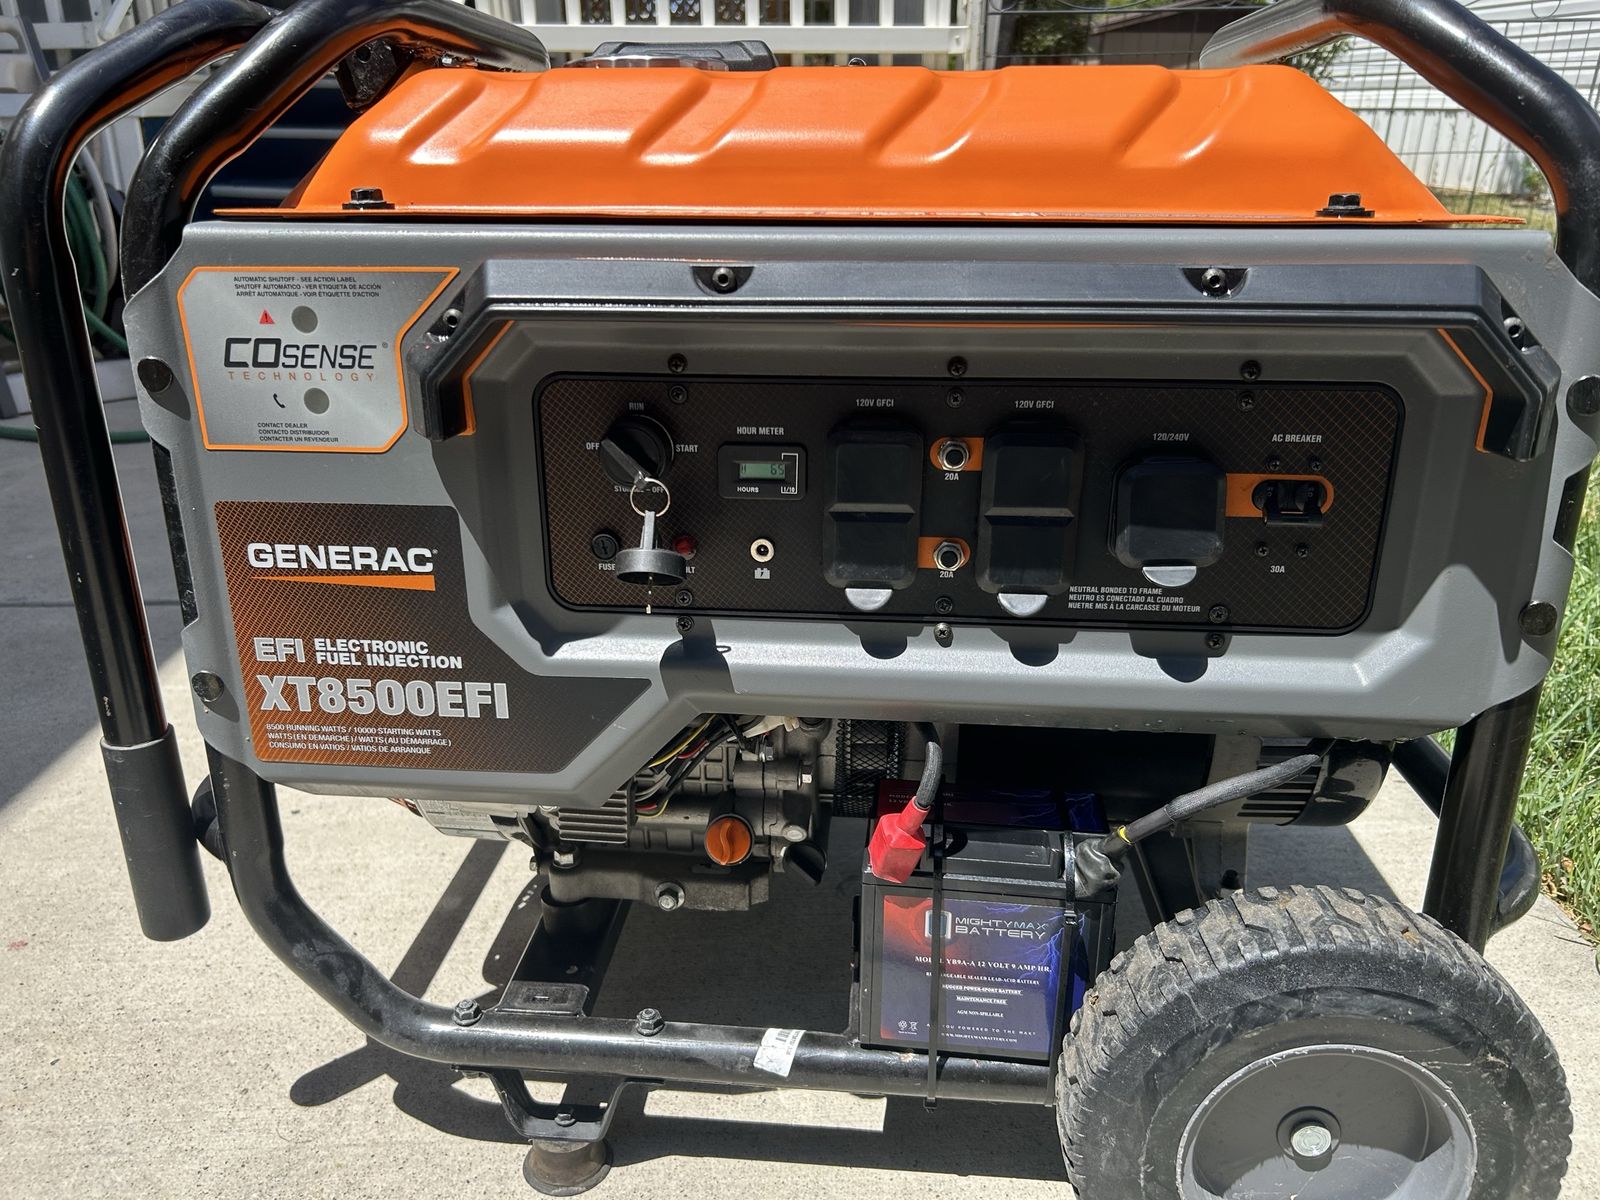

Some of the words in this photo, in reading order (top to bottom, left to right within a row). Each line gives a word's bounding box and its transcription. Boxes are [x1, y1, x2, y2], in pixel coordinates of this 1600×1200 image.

[228, 371, 374, 382] TECHNOLOGY
[629, 402, 644, 411] RUN
[855, 398, 874, 407] 120V
[876, 399, 894, 407] GFCI
[1014, 400, 1034, 409] 120V
[1036, 401, 1054, 409] GFCI
[736, 427, 756, 435] HOUR
[759, 427, 784, 436] METER
[1152, 432, 1189, 442] 120/240V
[1272, 434, 1283, 443] AC
[1285, 434, 1322, 443] BREAKER
[586, 442, 600, 451] OFF
[676, 444, 698, 453] START
[944, 473, 959, 481] 20A
[246, 542, 434, 573] GENERAC
[598, 563, 616, 571] FUSE
[1270, 565, 1285, 574] 30A
[1106, 595, 1145, 603] CONECTADO
[1172, 605, 1201, 613] MOTEUR
[253, 637, 305, 663] EFI
[314, 638, 428, 655] ELECTRONIC
[315, 651, 362, 667] FUEL
[367, 653, 463, 669] INJECTION
[258, 674, 510, 719] XT8500EFI
[286, 724, 321, 732] RUNNING
[321, 725, 347, 733] WATTS
[377, 728, 415, 736] STARTING
[416, 729, 441, 737] WATTS
[269, 741, 306, 749] CONSUMO
[390, 746, 431, 754] ARRANQUE
[955, 925, 1046, 940] BATTERY
[946, 958, 976, 967] YB9A-A
[1017, 964, 1036, 972] AMP
